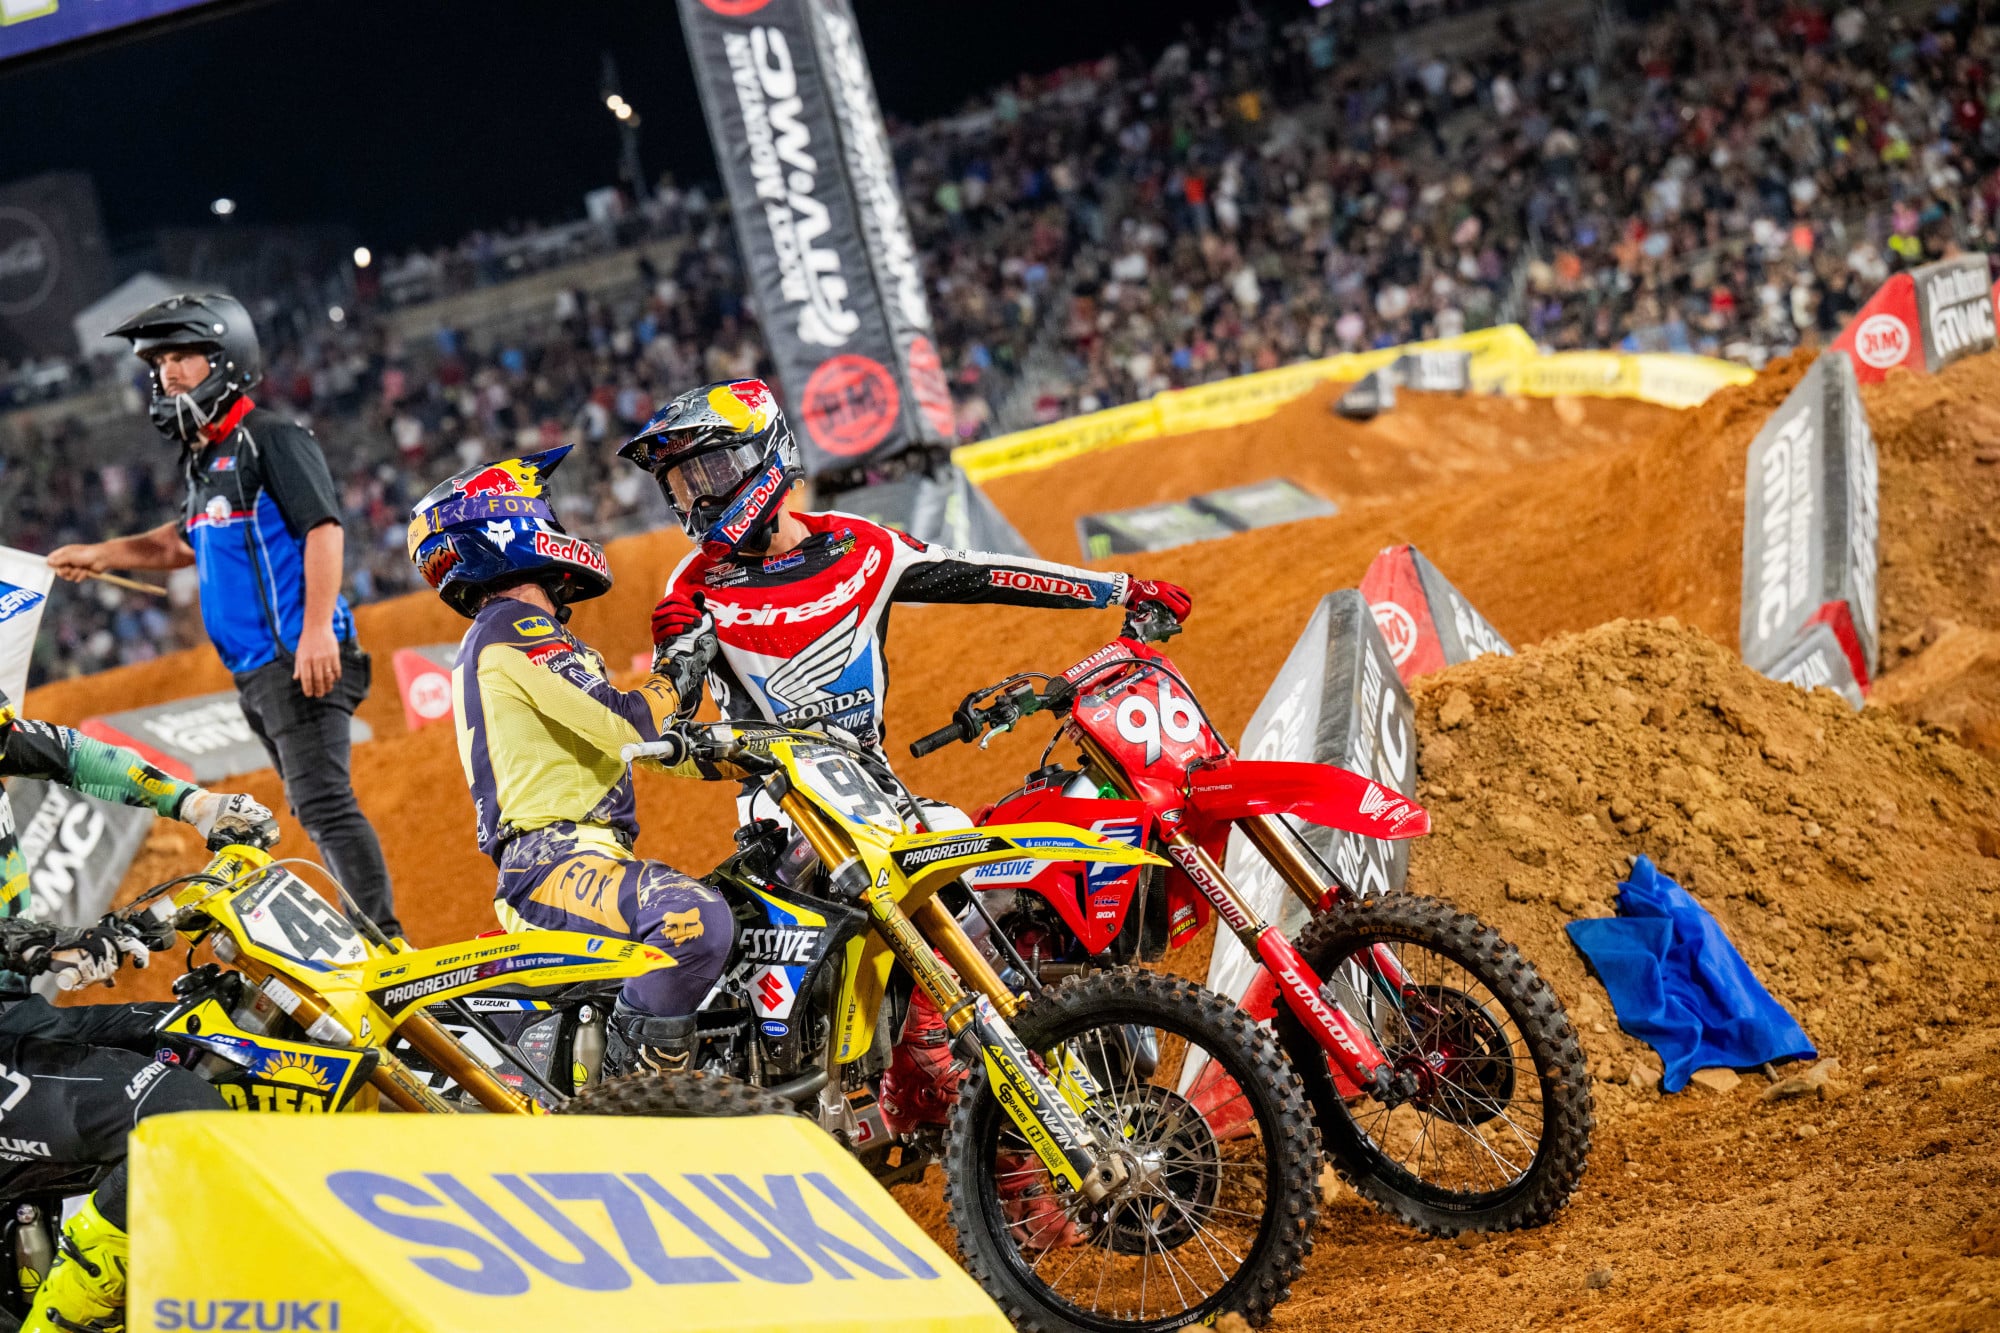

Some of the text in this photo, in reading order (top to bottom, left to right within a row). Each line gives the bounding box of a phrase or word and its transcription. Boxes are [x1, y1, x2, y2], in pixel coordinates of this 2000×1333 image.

[488, 499, 537, 513] FOX
[989, 569, 1096, 601] HONDA
[518, 617, 549, 631] WD-40
[1066, 643, 1118, 678] RENTHAL
[778, 688, 874, 727] HONDA
[1115, 677, 1201, 760] 96
[1197, 783, 1233, 793] TRUETIMBER
[1369, 798, 1406, 822] HONDA
[902, 838, 992, 867] PROGRESSIVE
[1054, 840, 1076, 848] Power
[560, 861, 613, 913] FOX
[1188, 867, 1250, 932] SHOWA
[267, 879, 356, 960] 45
[435, 943, 521, 967] KEEP IT TWISTED!
[537, 956, 565, 966] Power
[892, 922, 957, 997] REP
[384, 966, 479, 1006] PROGRESSIVE
[473, 999, 512, 1008] SUZUKI
[1279, 967, 1361, 1056] DUNLOP
[326, 1170, 942, 1297] SUZUKI
[154, 1298, 341, 1333] SUZUKI
